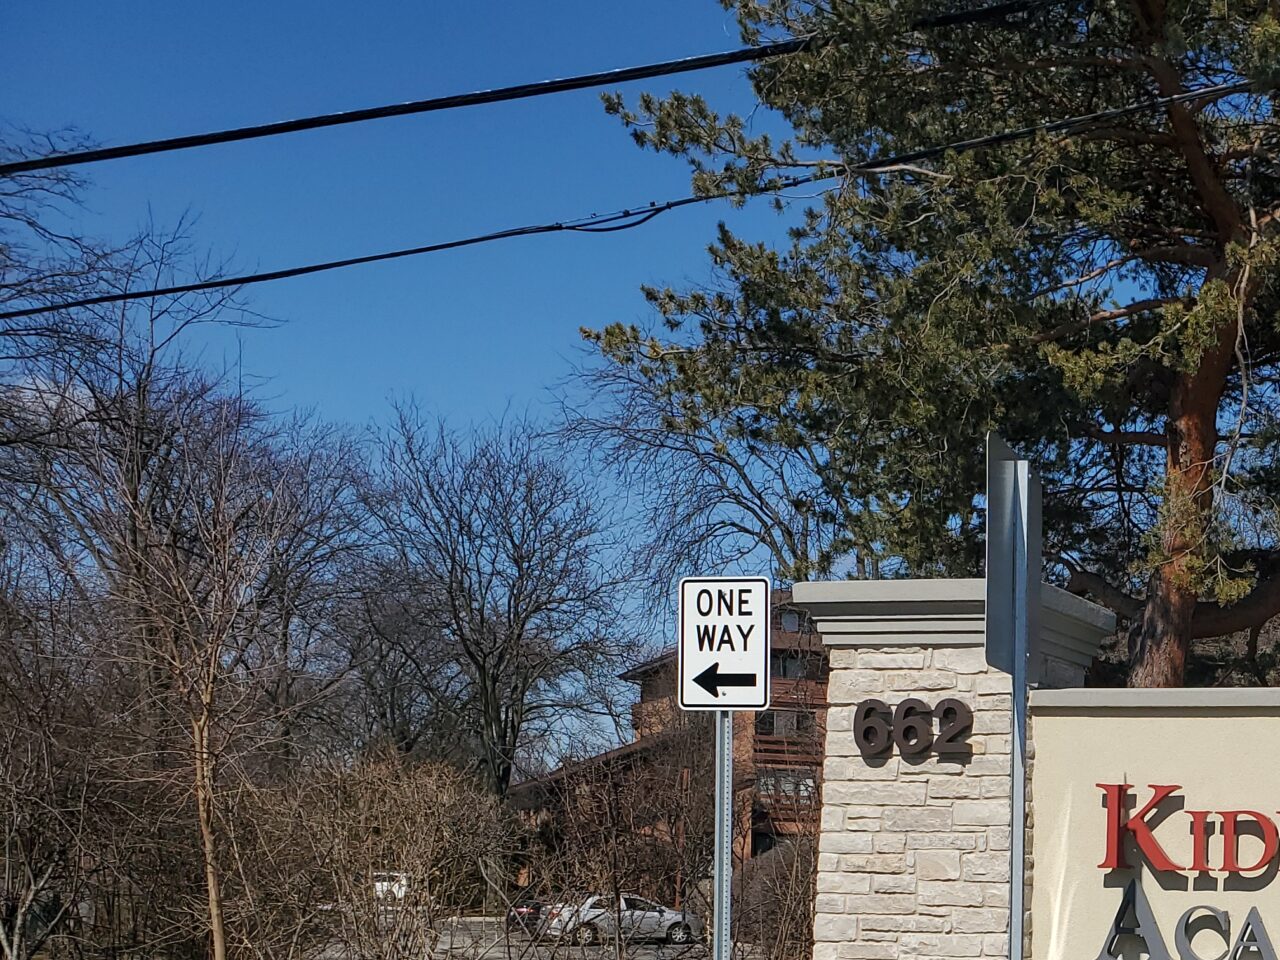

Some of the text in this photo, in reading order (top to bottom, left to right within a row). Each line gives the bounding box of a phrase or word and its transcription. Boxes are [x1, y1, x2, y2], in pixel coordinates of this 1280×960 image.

[697, 589, 753, 617] ONE
[696, 624, 755, 652] WAY
[853, 698, 973, 759] 662
